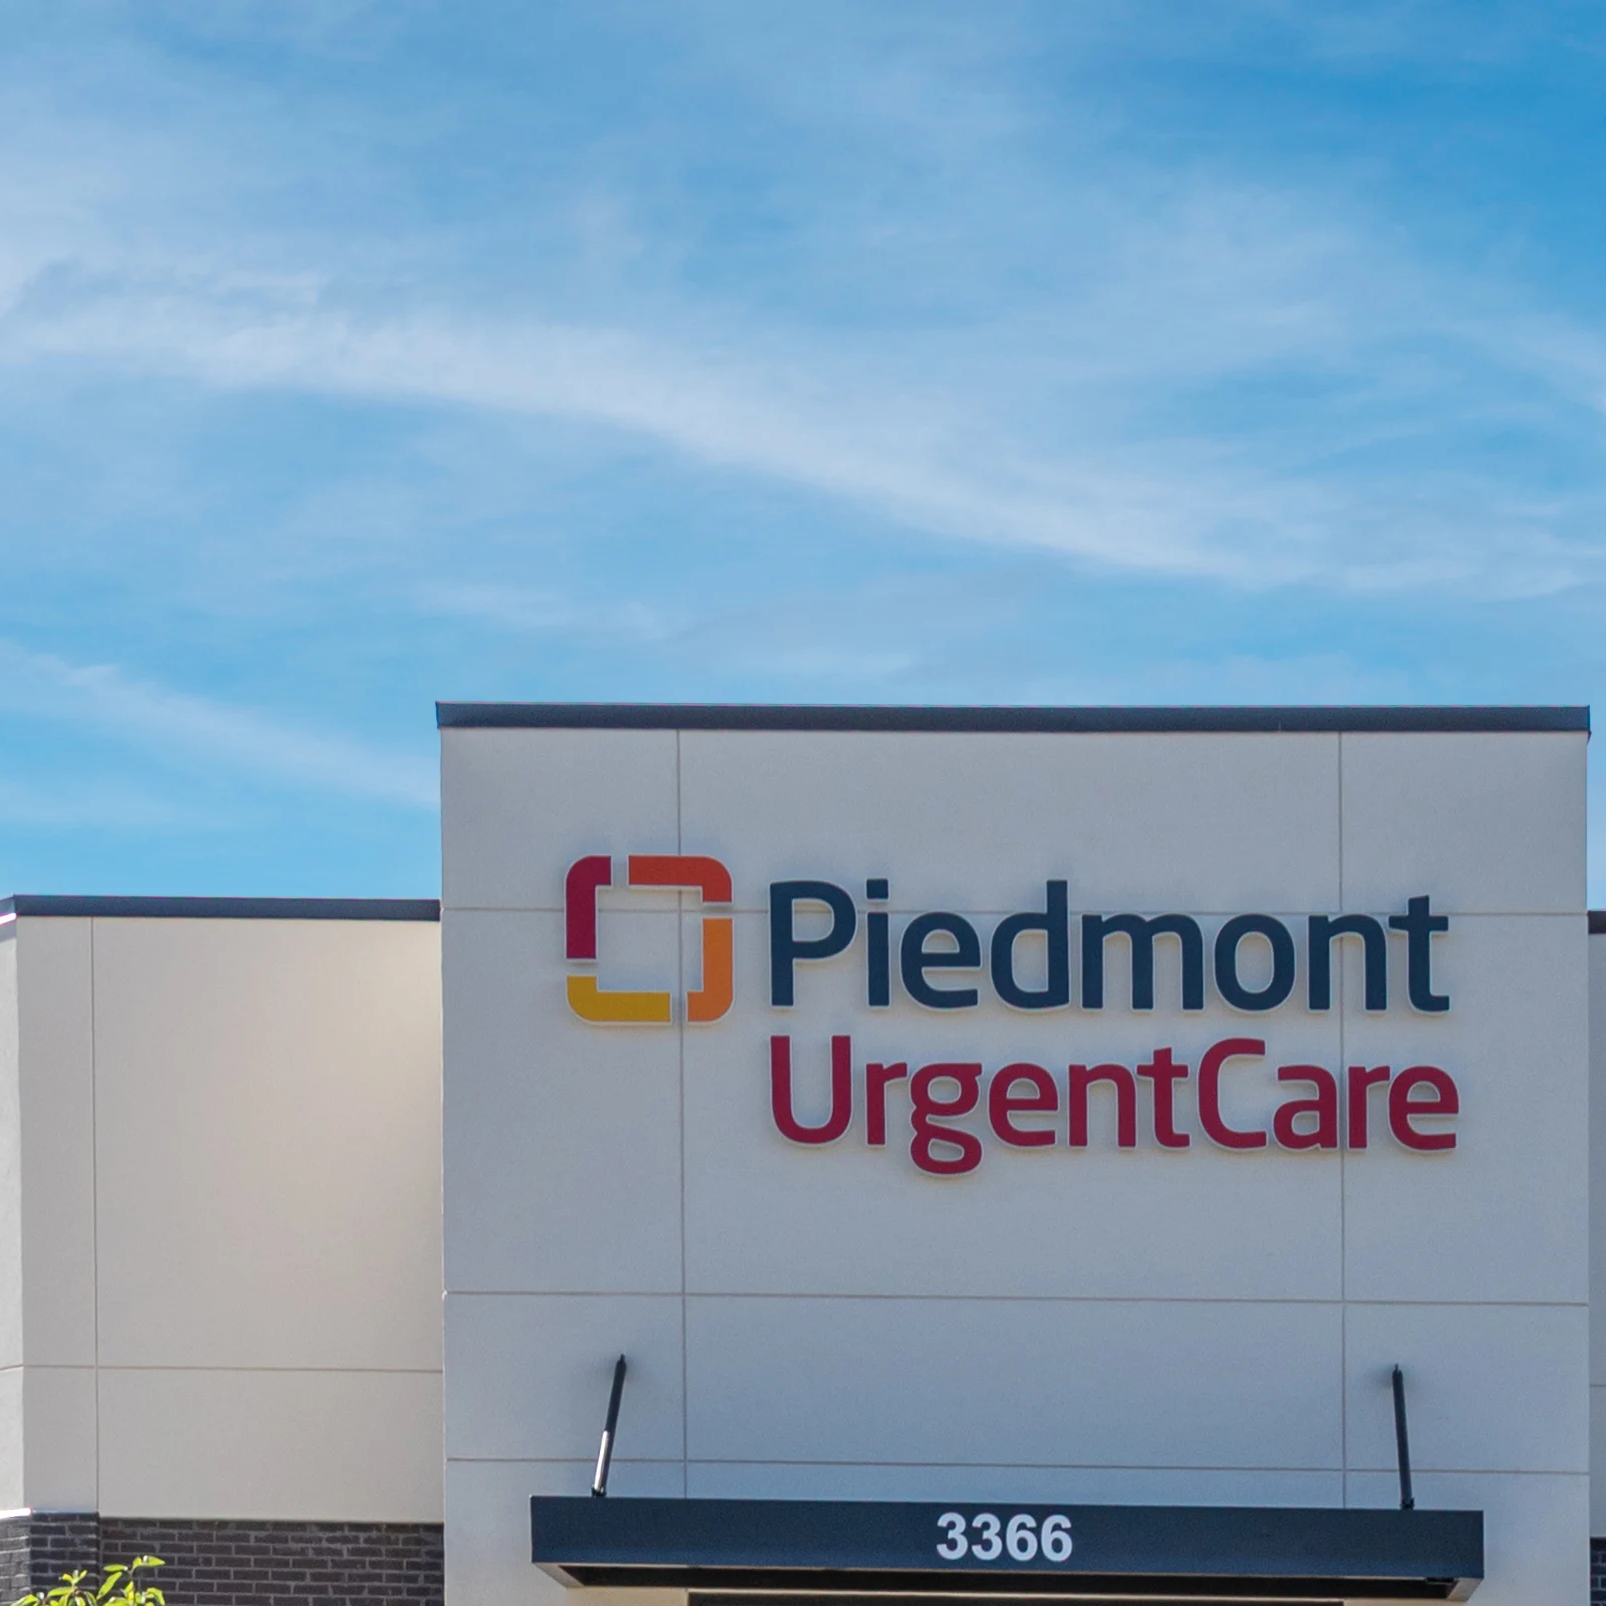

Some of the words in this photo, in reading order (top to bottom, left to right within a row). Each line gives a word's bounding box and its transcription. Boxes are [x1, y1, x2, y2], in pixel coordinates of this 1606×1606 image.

[769, 879, 1450, 1013] Piedmont
[769, 1035, 1460, 1176] UrgentCare
[936, 1511, 1073, 1562] 3366
